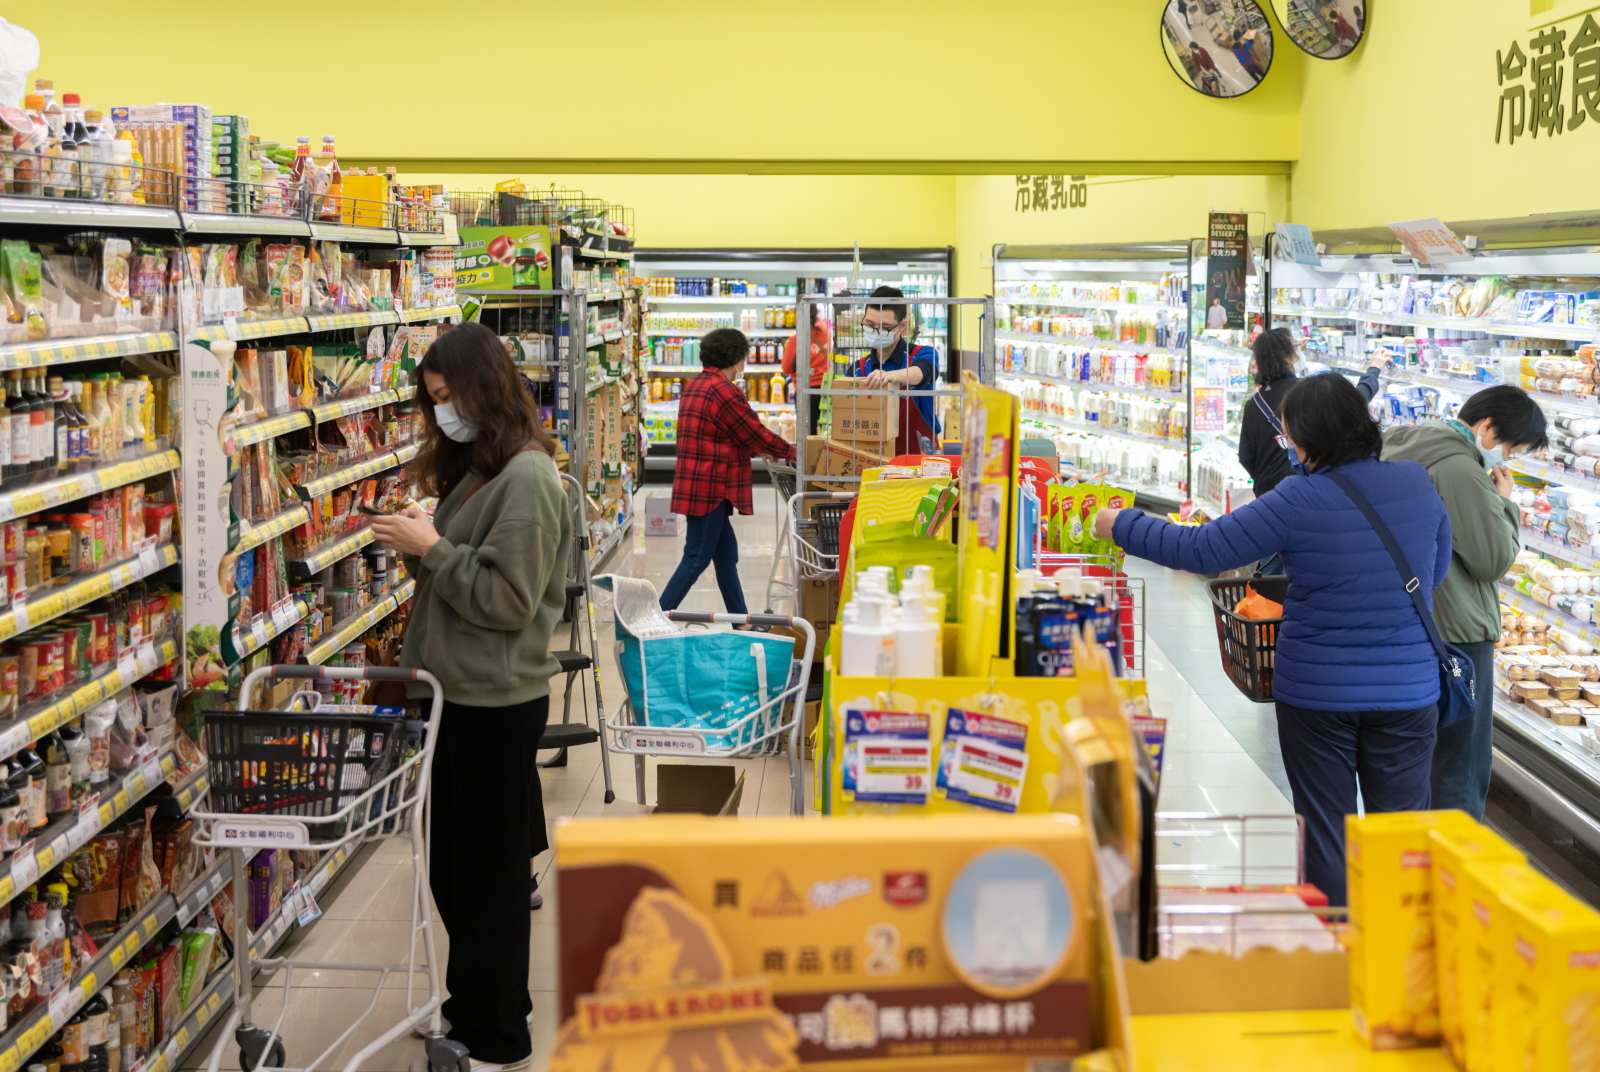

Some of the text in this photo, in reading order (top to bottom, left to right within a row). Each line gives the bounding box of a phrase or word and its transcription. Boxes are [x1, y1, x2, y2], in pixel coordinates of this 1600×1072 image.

[1015, 175, 1087, 213] 冷藏乳品
[1210, 223, 1246, 231] CHOCOLATE
[905, 775, 922, 789] 39
[994, 783, 1013, 798] 39
[240, 830, 295, 839] 全聯福利中心
[584, 989, 766, 1029] TOBLERONE
